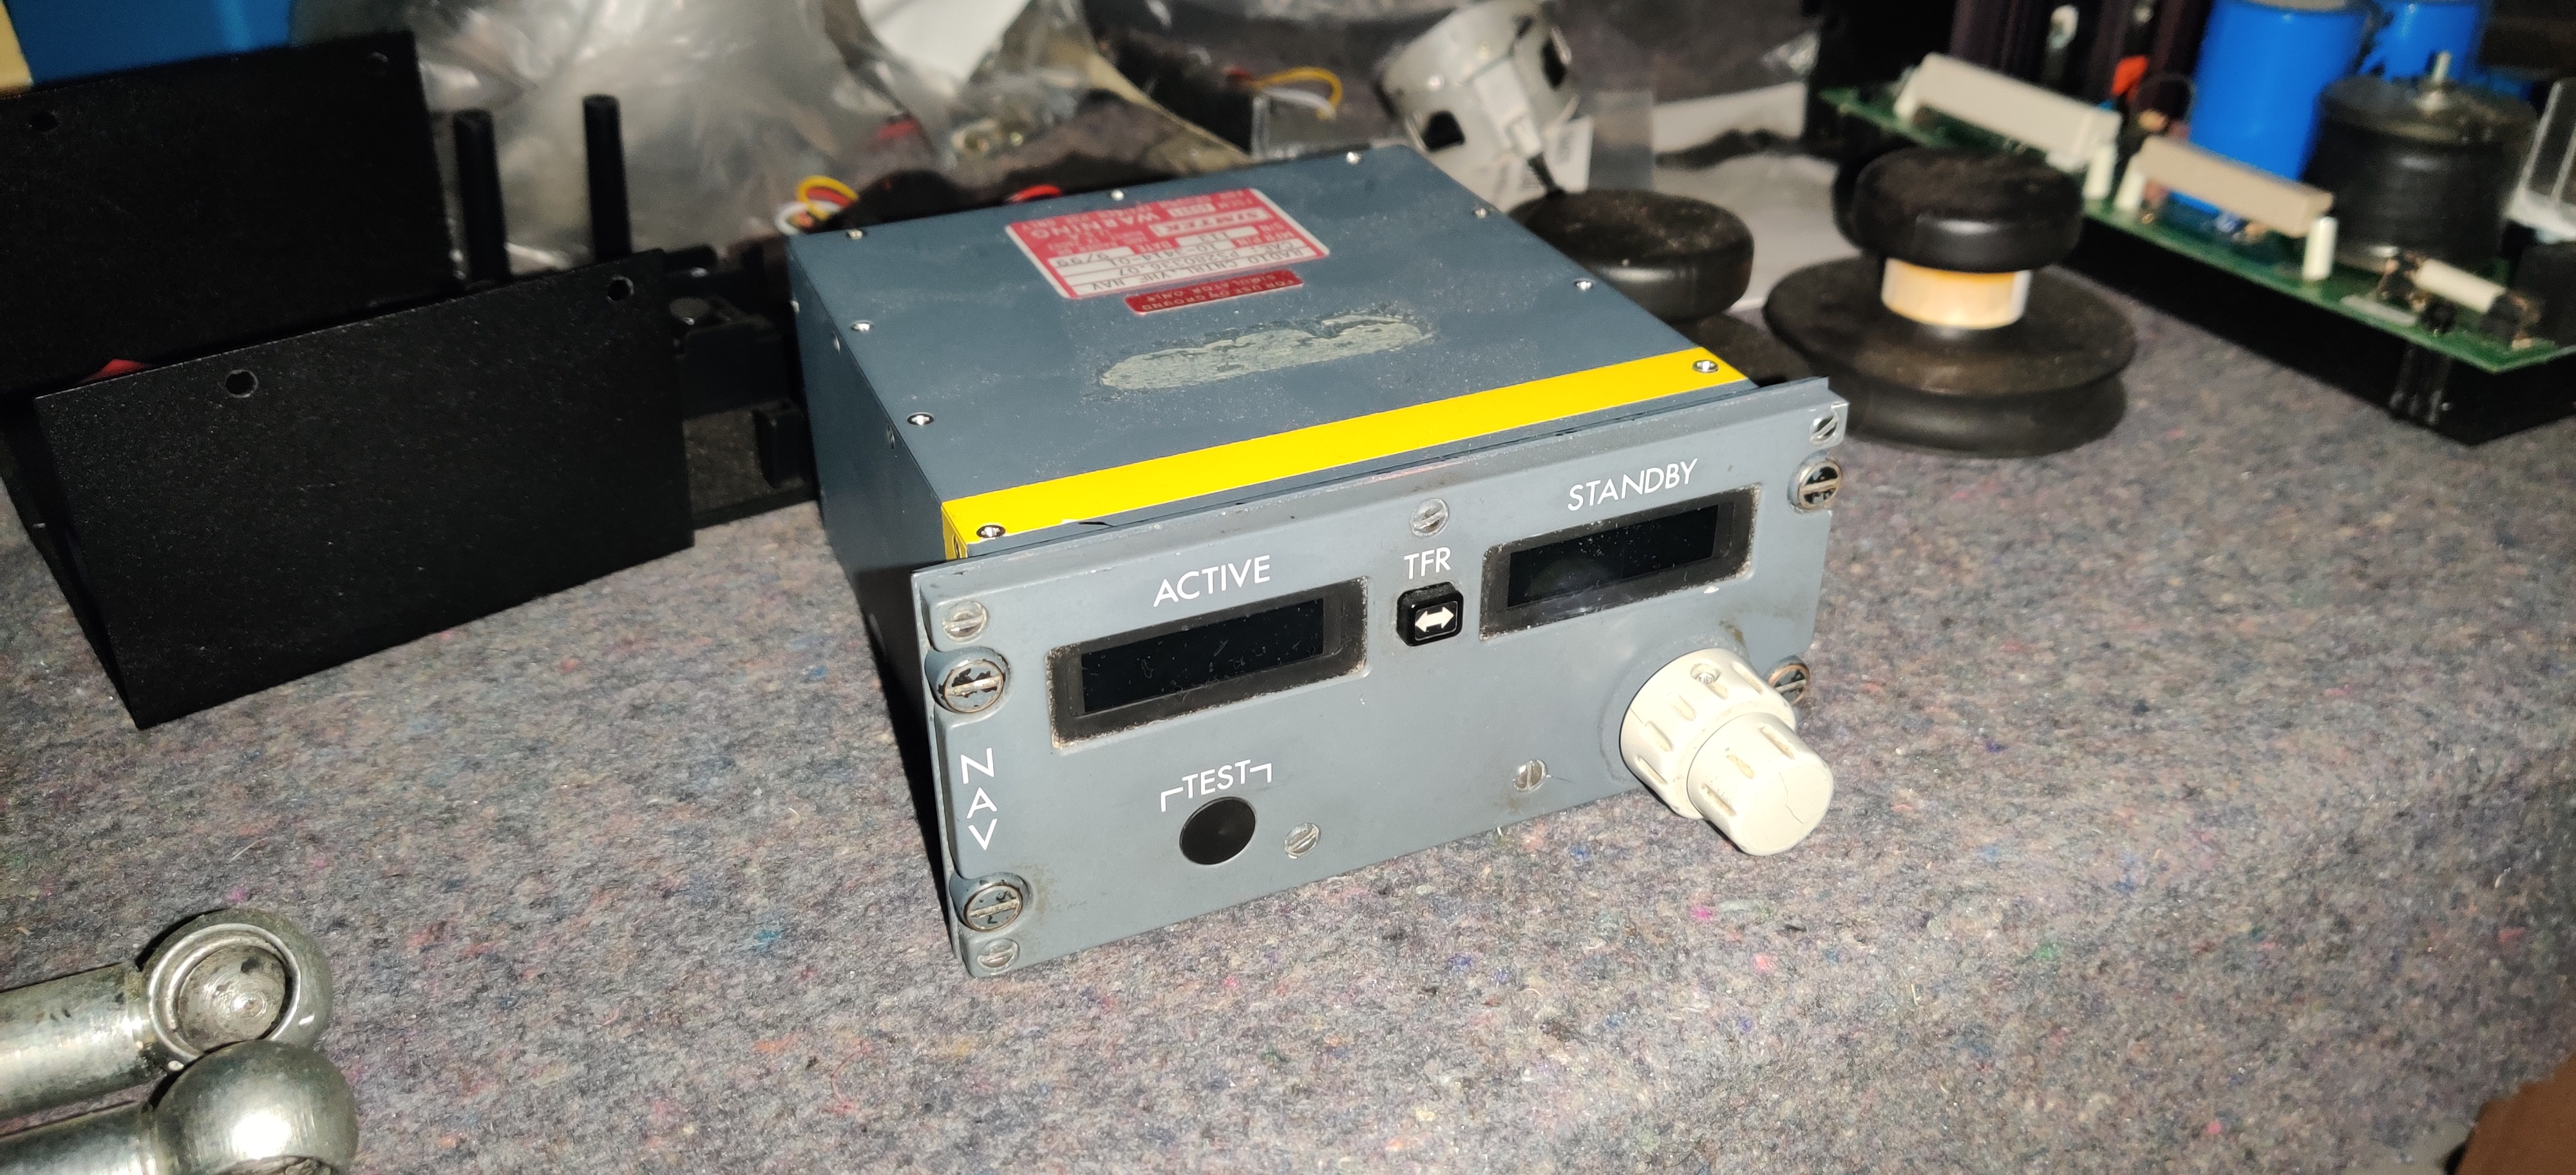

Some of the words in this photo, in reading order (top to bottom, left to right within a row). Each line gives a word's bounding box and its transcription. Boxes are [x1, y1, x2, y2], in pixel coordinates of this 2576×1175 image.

[1030, 213, 1159, 237] WARNING
[1164, 213, 1258, 231] SIMTEK
[1197, 232, 1231, 242] 113
[1135, 241, 1172, 251] DATE
[1249, 241, 1294, 253] CAE:
[1055, 252, 1109, 266] 9/99
[1108, 244, 1217, 265] 10-3414-01
[1247, 249, 1304, 263] RADIO
[1090, 279, 1124, 289] NAV
[1191, 274, 1275, 293] SIMULATOR
[1234, 285, 1261, 293] USE
[1146, 290, 1183, 301] ONLY
[1208, 289, 1229, 298] ON
[1142, 295, 1205, 310] GROUND
[1567, 458, 1698, 511] STANDBY
[1404, 546, 1452, 580] TFR
[1153, 555, 1271, 607] ACTIVE
[1182, 759, 1252, 799] TEST
[960, 747, 998, 850] NAV
